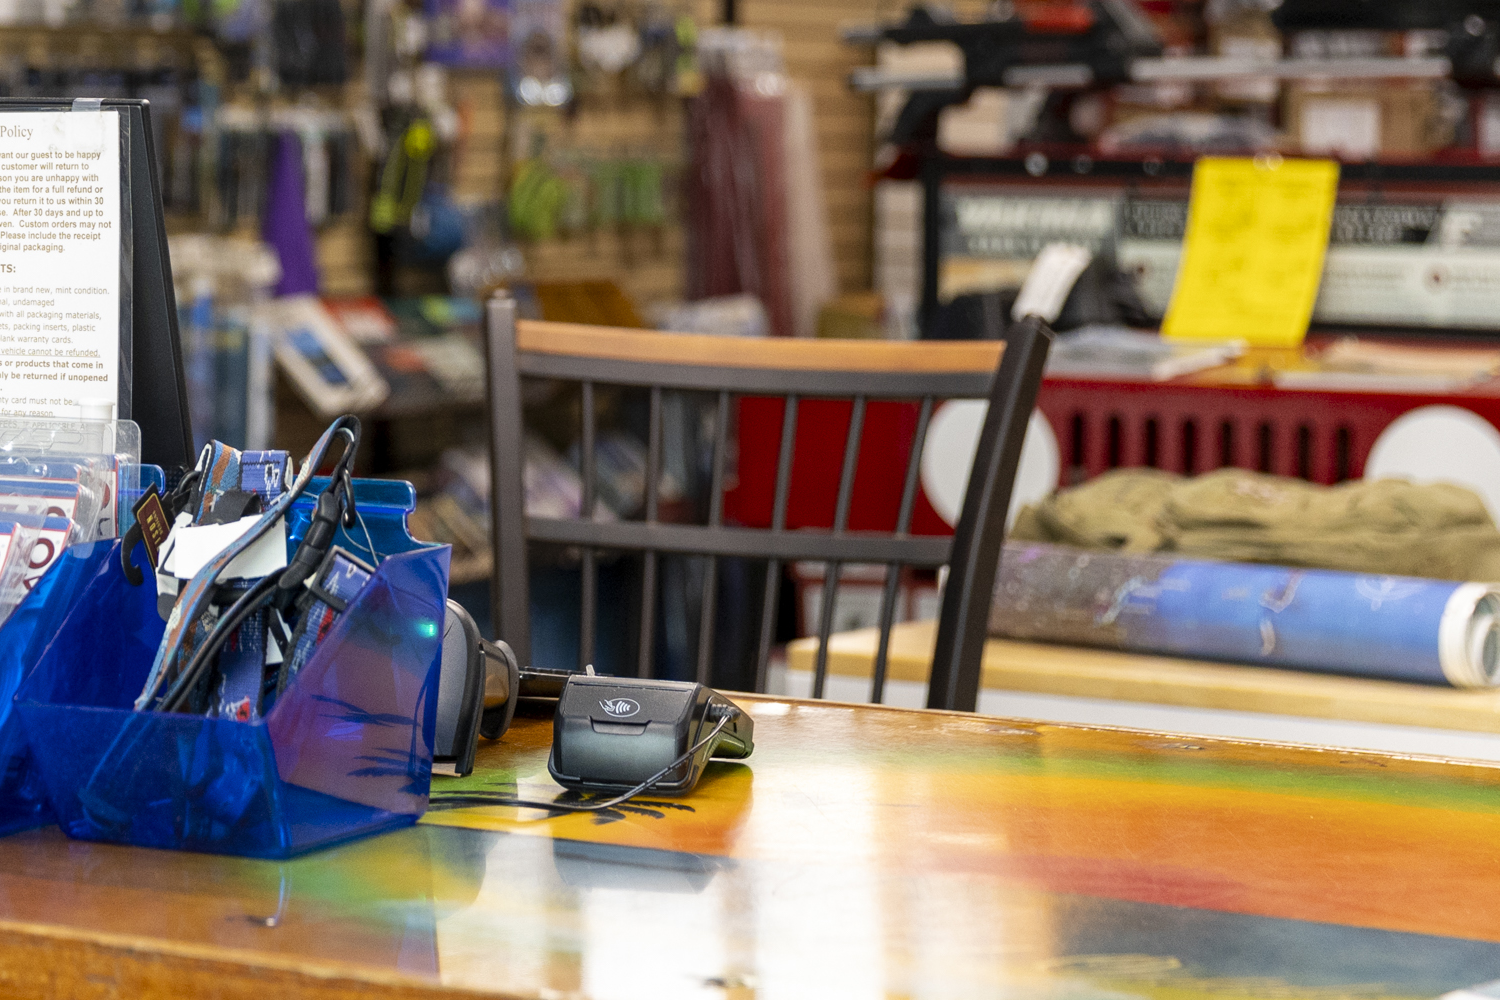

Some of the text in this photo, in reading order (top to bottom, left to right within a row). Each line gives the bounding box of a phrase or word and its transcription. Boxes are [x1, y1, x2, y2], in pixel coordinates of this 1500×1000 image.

[0, 124, 34, 141] Policy
[30, 150, 53, 161] guest
[76, 151, 102, 161] happy
[1, 163, 38, 171] customer
[55, 162, 79, 171] return
[15, 359, 51, 369] products
[23, 372, 109, 383] returned unopened
